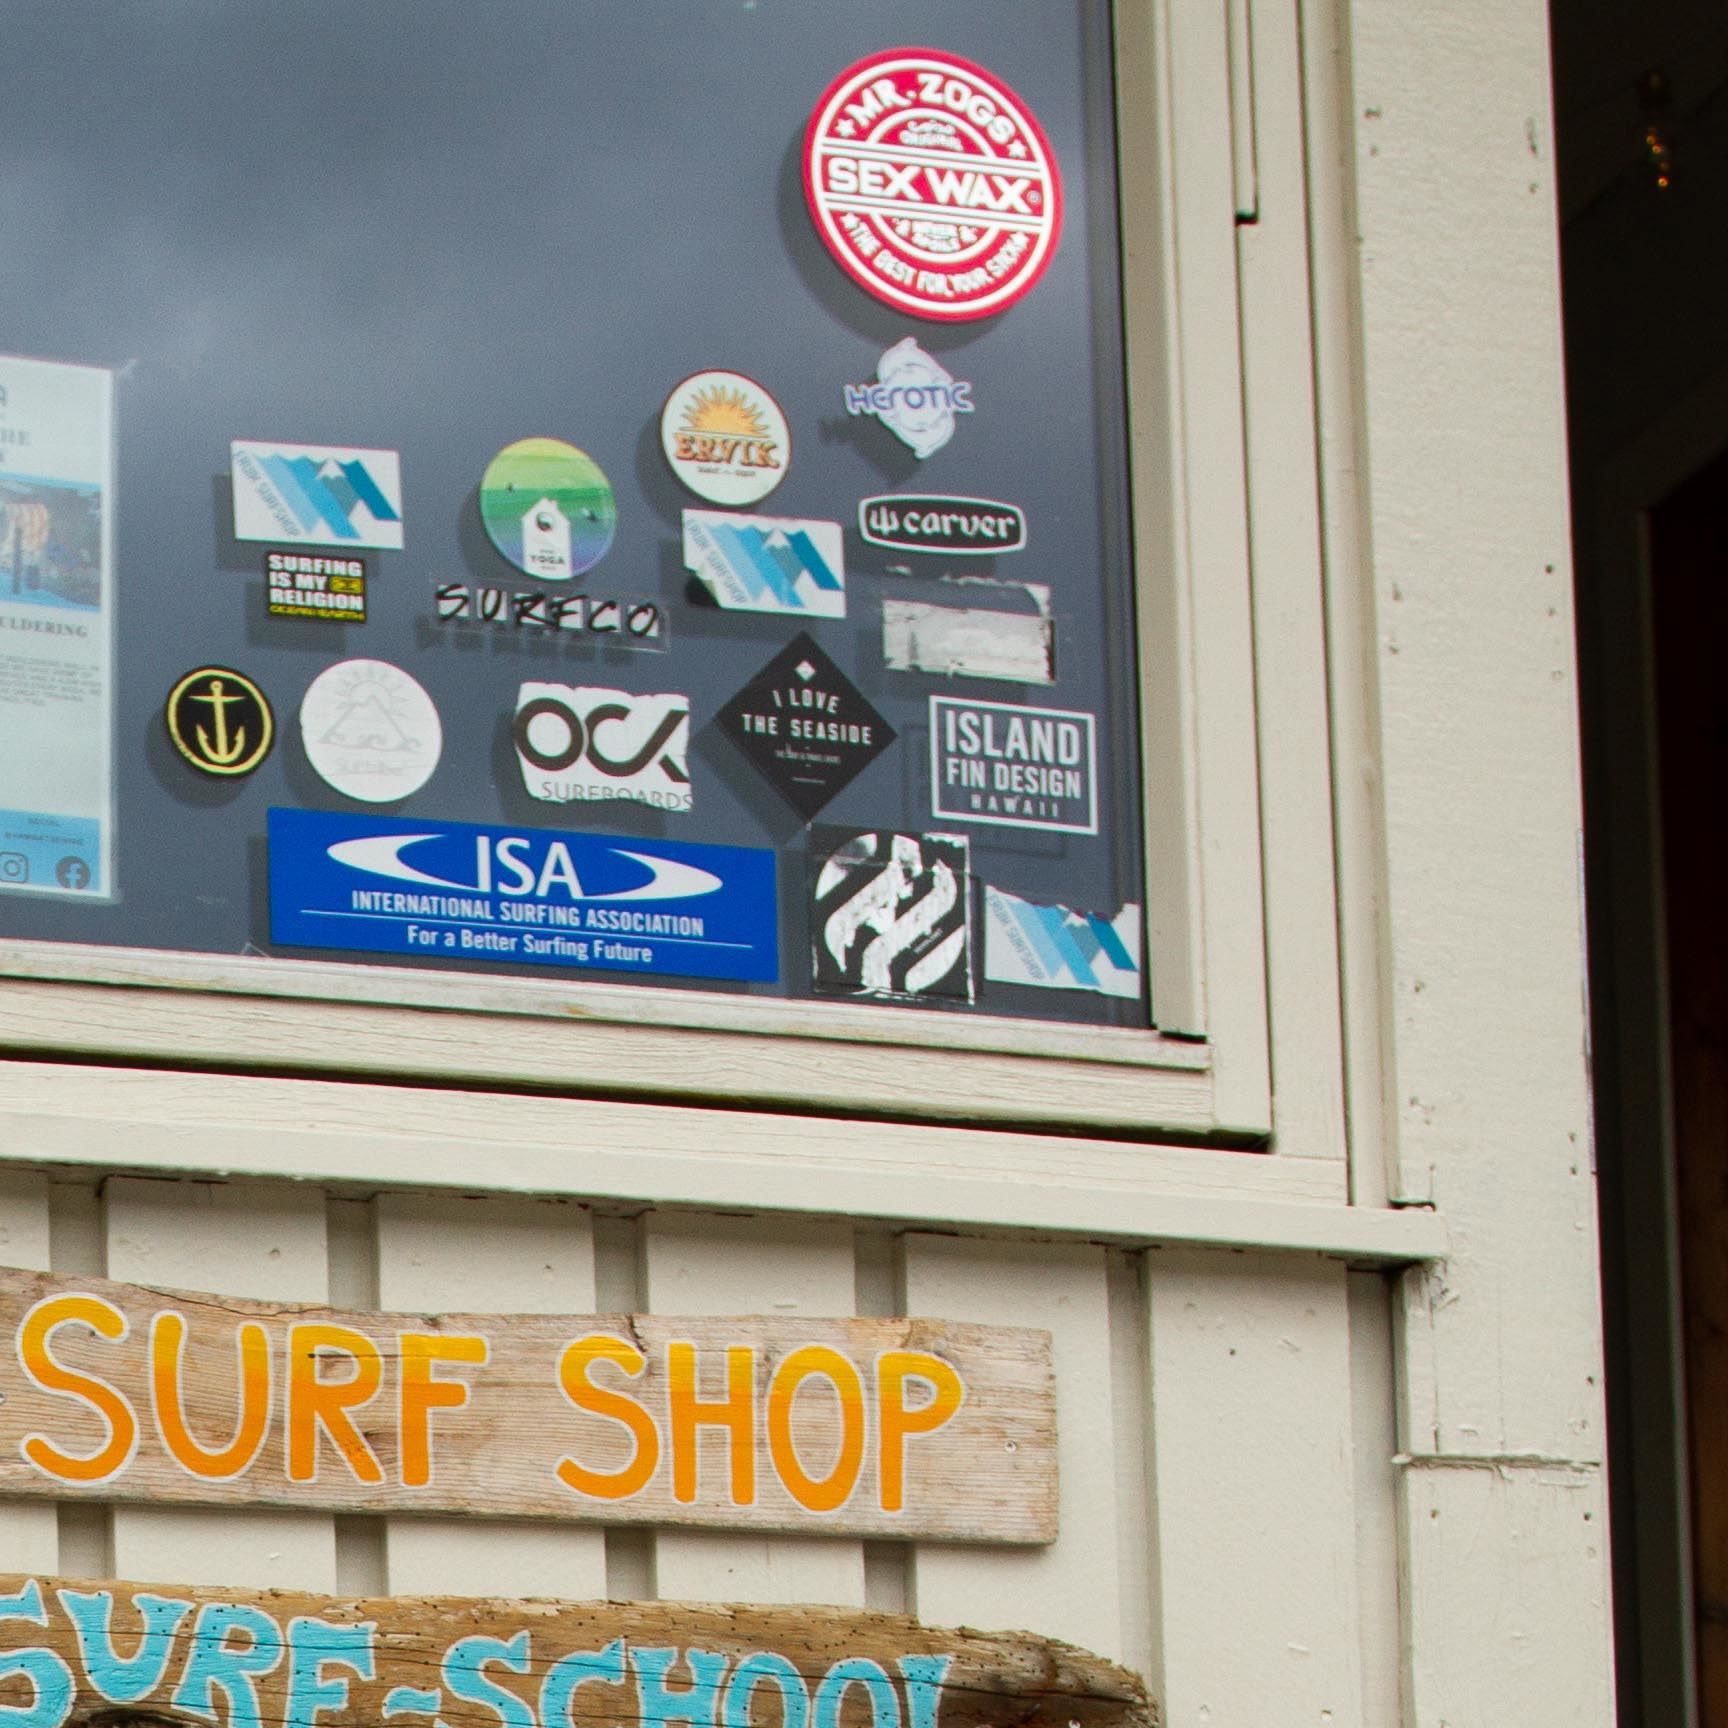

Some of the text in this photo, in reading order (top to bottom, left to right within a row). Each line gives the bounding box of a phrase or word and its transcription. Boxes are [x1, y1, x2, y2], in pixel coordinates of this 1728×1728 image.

[846, 73, 1016, 144] MR. ZOGS
[828, 157, 1032, 215] SEX WAX
[873, 249, 917, 287] BEST
[903, 511, 1016, 539] carver
[268, 554, 363, 577] SURFING
[269, 571, 328, 591] IS MY
[270, 588, 364, 611] RELIGION
[435, 583, 658, 637] SURFCO
[772, 688, 840, 714] I LOVE
[742, 713, 872, 745] THE SEASIDE
[945, 709, 1081, 765] ISLAND
[946, 757, 1082, 800] FIN DESIGN
[971, 794, 1059, 818] HAWAII
[476, 834, 584, 899] ISA
[351, 889, 704, 937] INTERNATIONAL SURFING ASSOCIATION
[407, 924, 653, 963] For a Better Surfing Future
[15, 1292, 964, 1514] SURF SHOP
